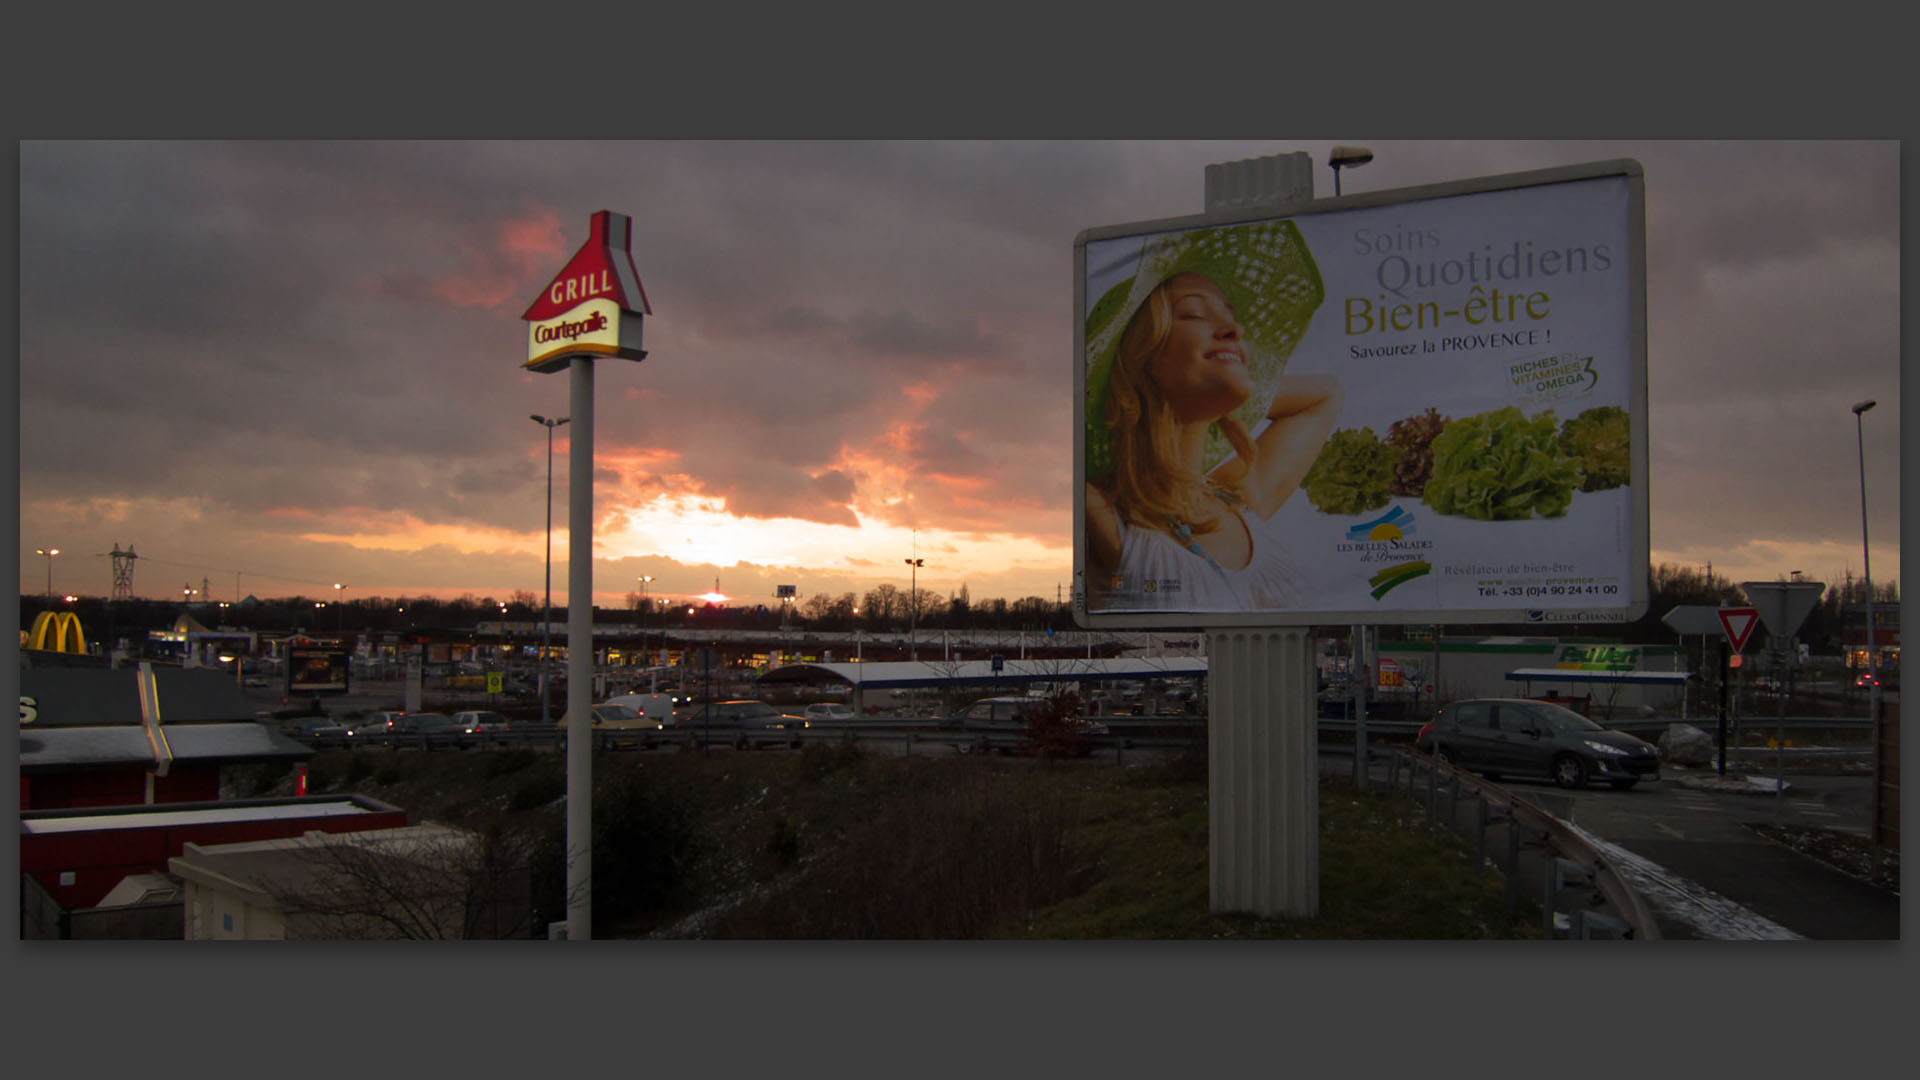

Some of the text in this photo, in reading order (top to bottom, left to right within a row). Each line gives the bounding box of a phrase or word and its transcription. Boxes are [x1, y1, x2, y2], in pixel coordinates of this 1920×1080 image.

[1353, 224, 1441, 256] Soins
[1376, 241, 1612, 299] Quotidiens
[551, 269, 613, 304] GRILL
[1345, 285, 1550, 336] Bien-être
[1350, 343, 1417, 359] Savourez
[1424, 341, 1436, 353] la
[1442, 330, 1538, 352] PROVENCE
[1510, 356, 1559, 375] RICHES
[1511, 362, 1583, 386] VITAMINES
[1536, 373, 1585, 392] OMEGA
[1360, 550, 1373, 563] de
[1507, 562, 1520, 574] de
[1502, 586, 1523, 596] +33
[1526, 586, 1547, 598] (0)4
[1551, 585, 1565, 595] 90
[1568, 585, 1582, 595] 24
[1586, 584, 1599, 595] 41
[1603, 584, 1618, 595] 00
